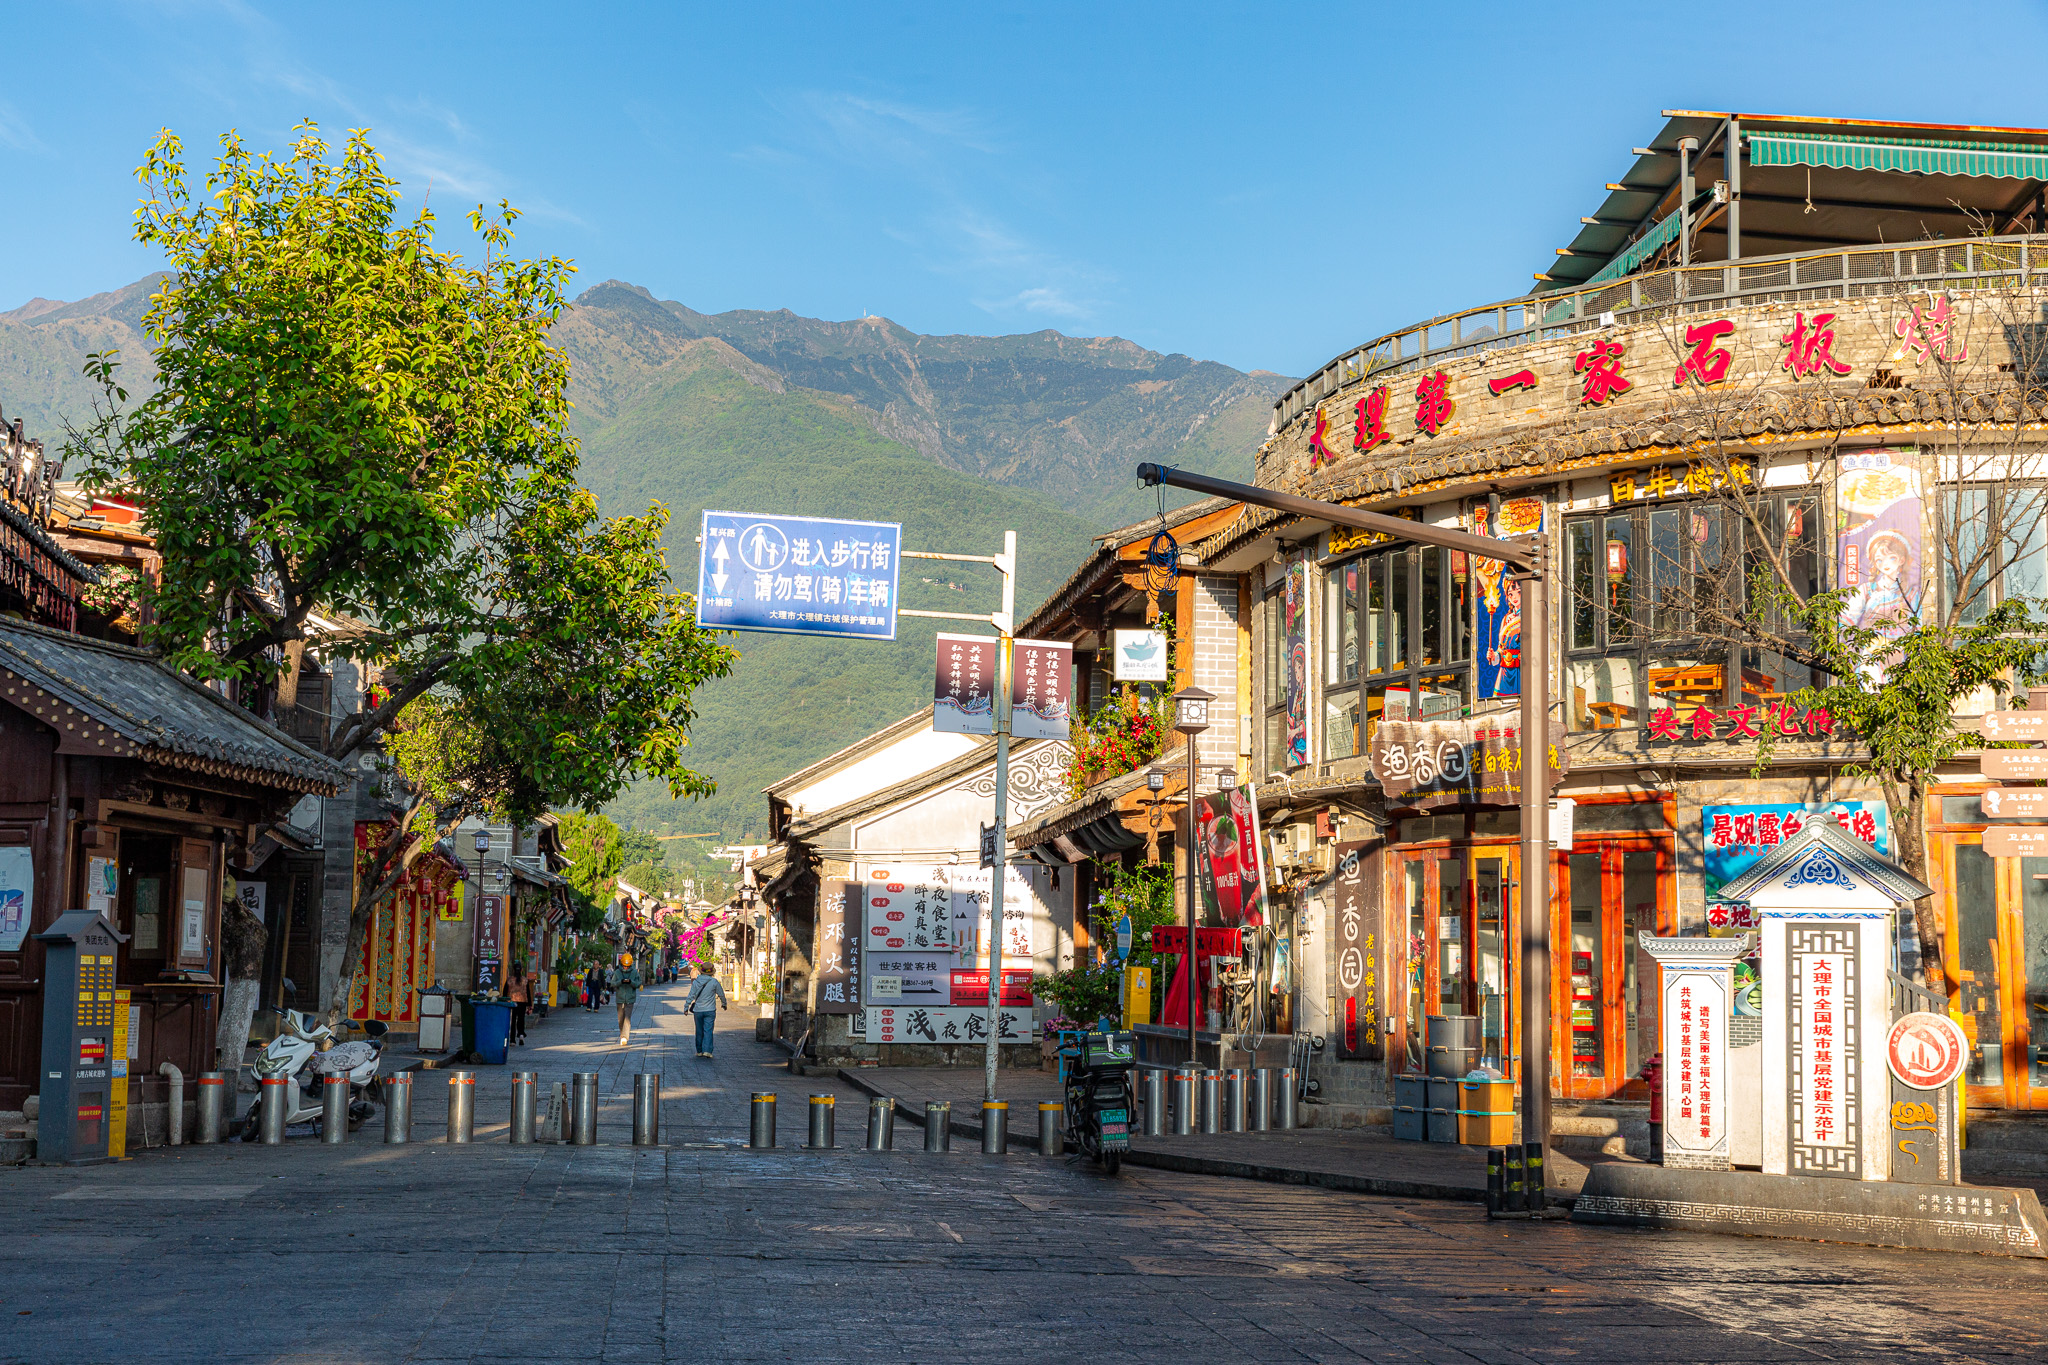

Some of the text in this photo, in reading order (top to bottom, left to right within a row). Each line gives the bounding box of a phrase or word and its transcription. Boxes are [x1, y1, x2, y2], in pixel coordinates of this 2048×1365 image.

[709, 527, 736, 538] 复兴路
[791, 538, 891, 571] 进入步行街
[1847, 547, 1858, 582] 民族风味
[754, 572, 890, 608] 请勿驾(骑)车辆
[769, 610, 885, 627] 大理市大理镇古城保护管理局
[968, 645, 982, 698] 共建文明大理
[1024, 649, 1038, 704] 倡导绿色出行
[1474, 728, 1521, 741] 百年老
[1648, 702, 1854, 741] 美食文化传
[2005, 717, 2044, 726] 复兴路
[1380, 738, 1468, 786] 渔香园
[1468, 743, 1561, 774] 老白族烧
[2001, 756, 2041, 764] 天主教堂
[1447, 786, 1458, 795] old
[1474, 783, 1503, 794] People's
[1505, 781, 1521, 793] Flag
[2006, 793, 2044, 802] 玉洱路
[1712, 811, 1877, 847] 景观露台烧
[2007, 833, 2045, 842] 卫生间
[966, 890, 990, 904] 民宿
[985, 910, 1024, 920] 旅咨询
[1339, 849, 1363, 989] 渔香园
[1708, 904, 1761, 930] 本地
[85, 935, 109, 945] 美团充电
[824, 892, 847, 1003] 诺邓火腿
[1018, 934, 1030, 955] 大理
[850, 936, 858, 1003] 可以生吃的火腿
[879, 961, 938, 971] 世安堂客栈
[1364, 932, 1376, 1045] 老白族石板烧
[1681, 987, 1692, 1119] 共筑城市基层党建同心圆
[1811, 959, 1834, 1142] 大理市全国城市基层党建示范市
[1699, 1006, 1711, 1139] 谱写美丽幸福大理新篇章
